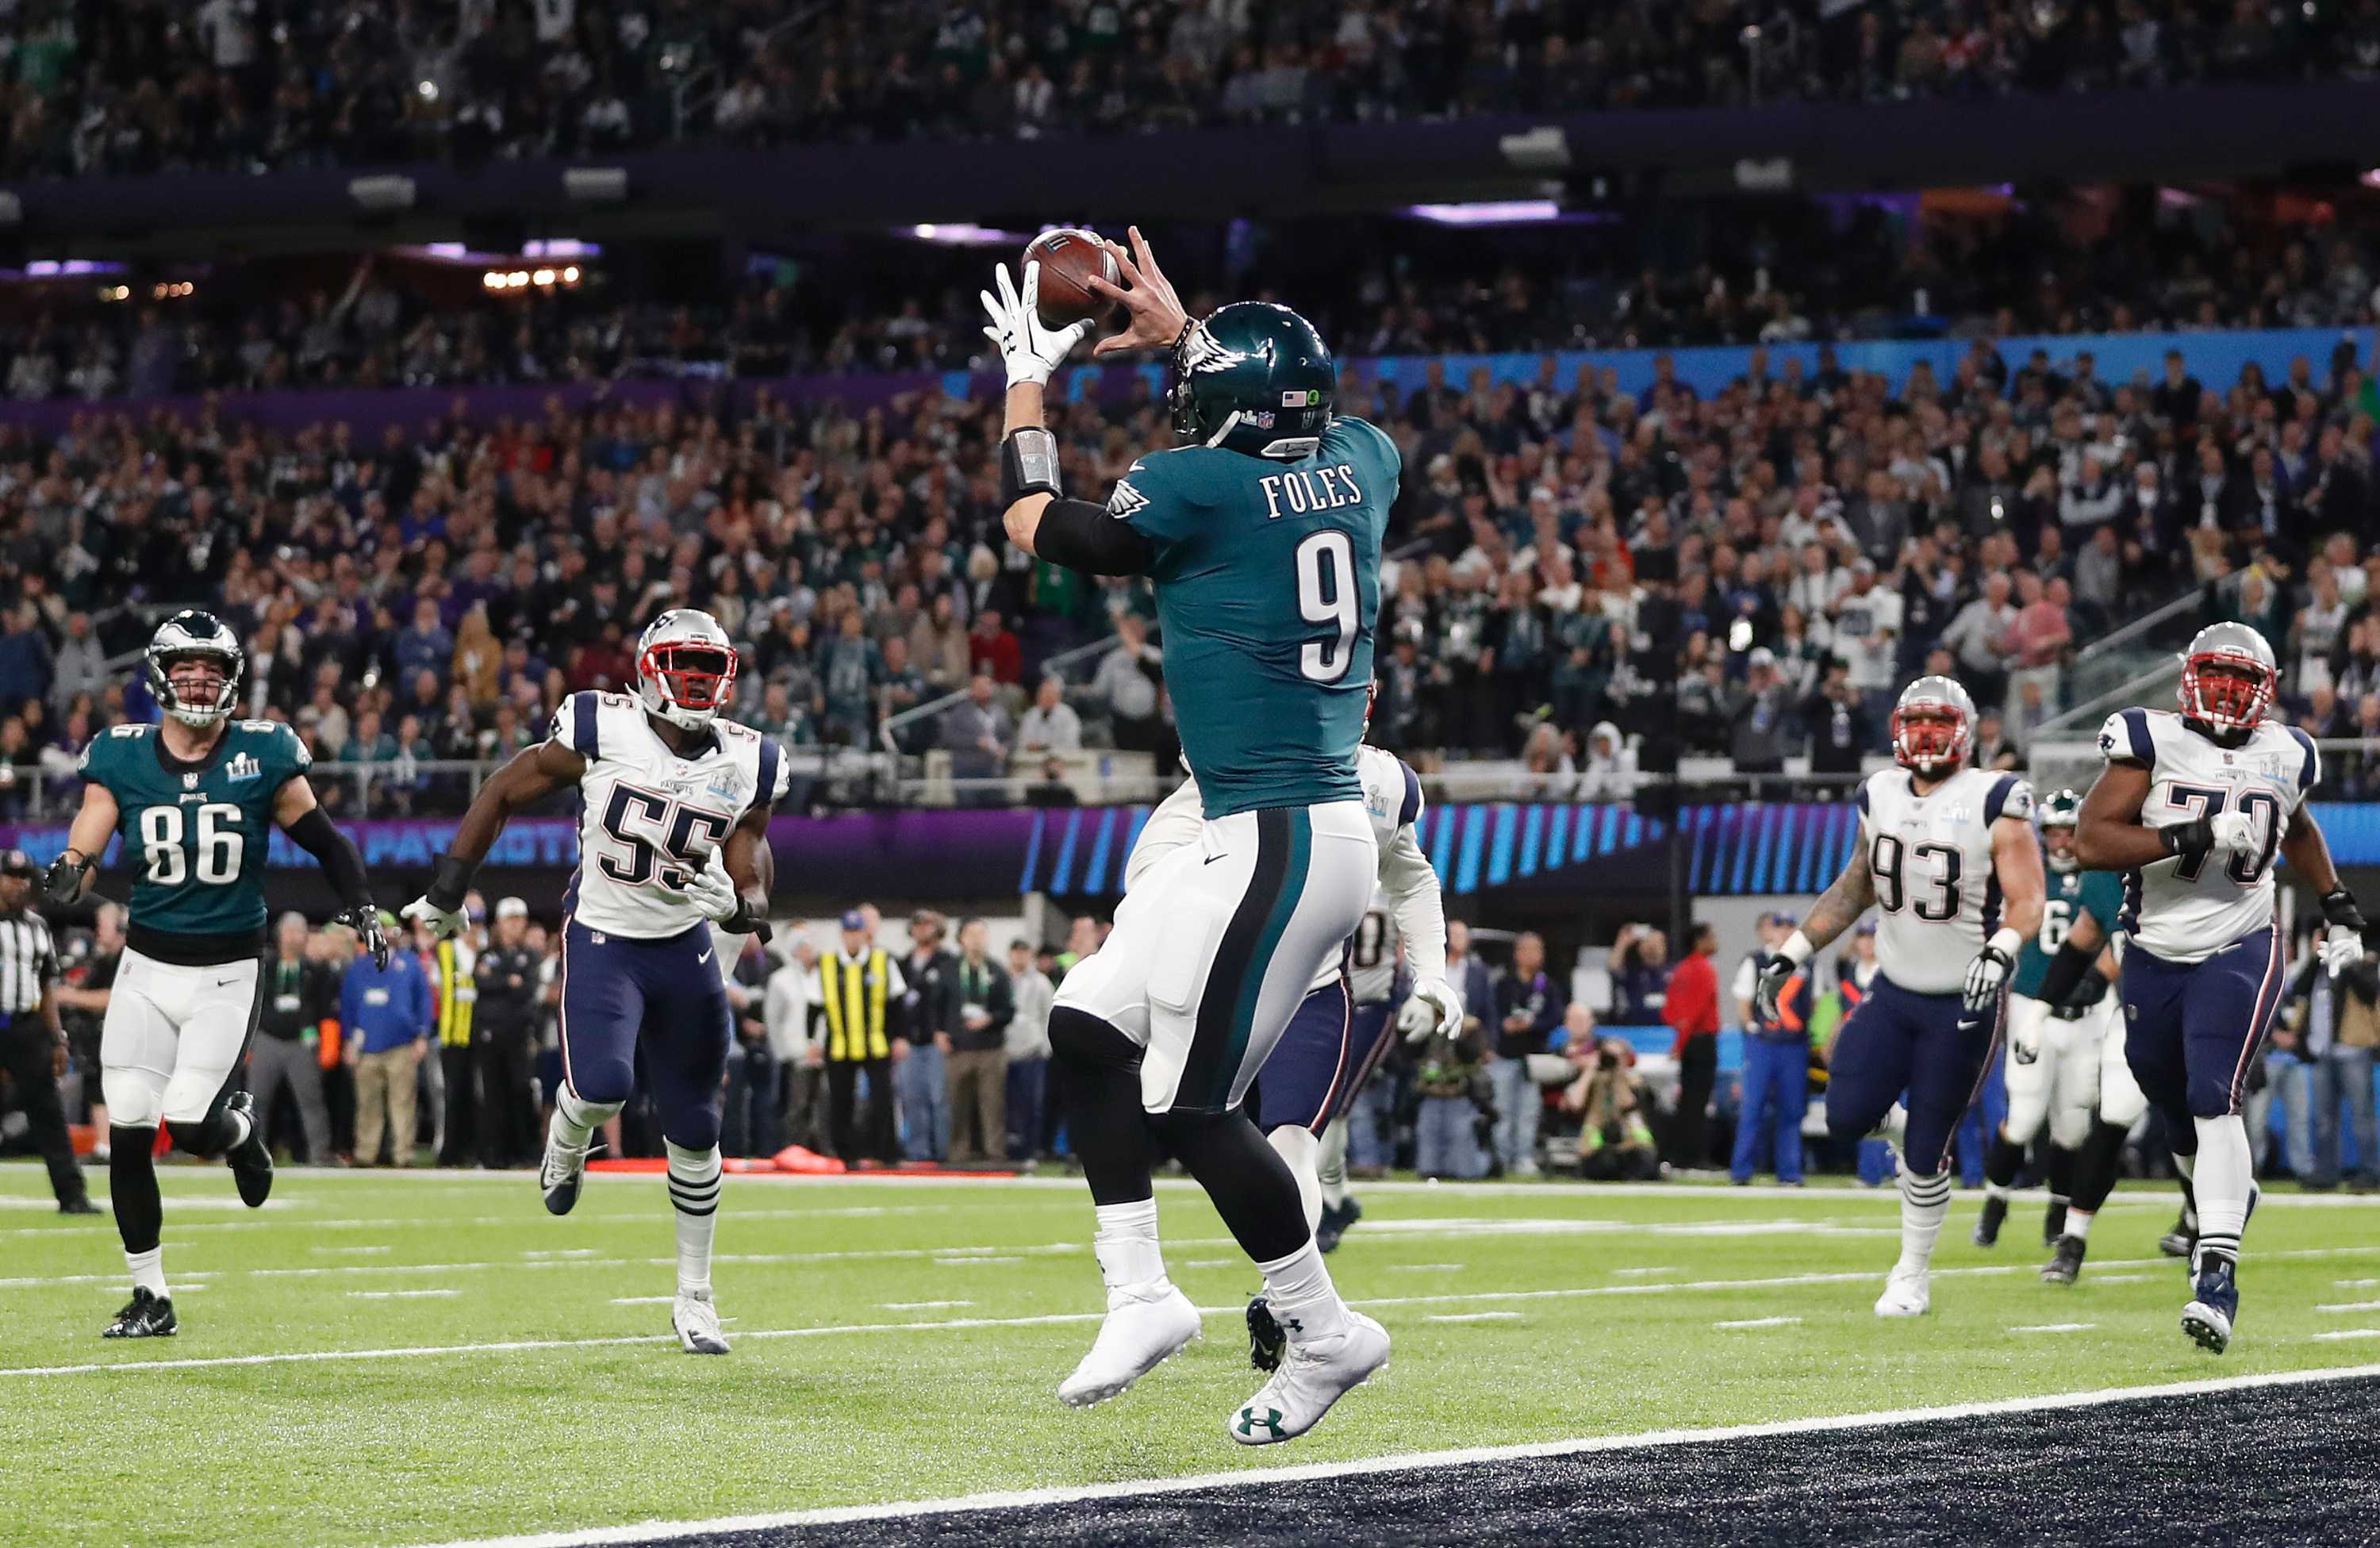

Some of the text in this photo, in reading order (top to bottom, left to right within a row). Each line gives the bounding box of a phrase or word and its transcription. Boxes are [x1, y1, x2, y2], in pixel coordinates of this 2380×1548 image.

[1258, 464, 1362, 519] FOLES
[1296, 530, 1361, 684] 9
[140, 803, 244, 884] 86
[597, 778, 734, 890] 55
[1870, 828, 1964, 924] 93
[2166, 780, 2281, 888] 70
[2039, 900, 2071, 955] 6
